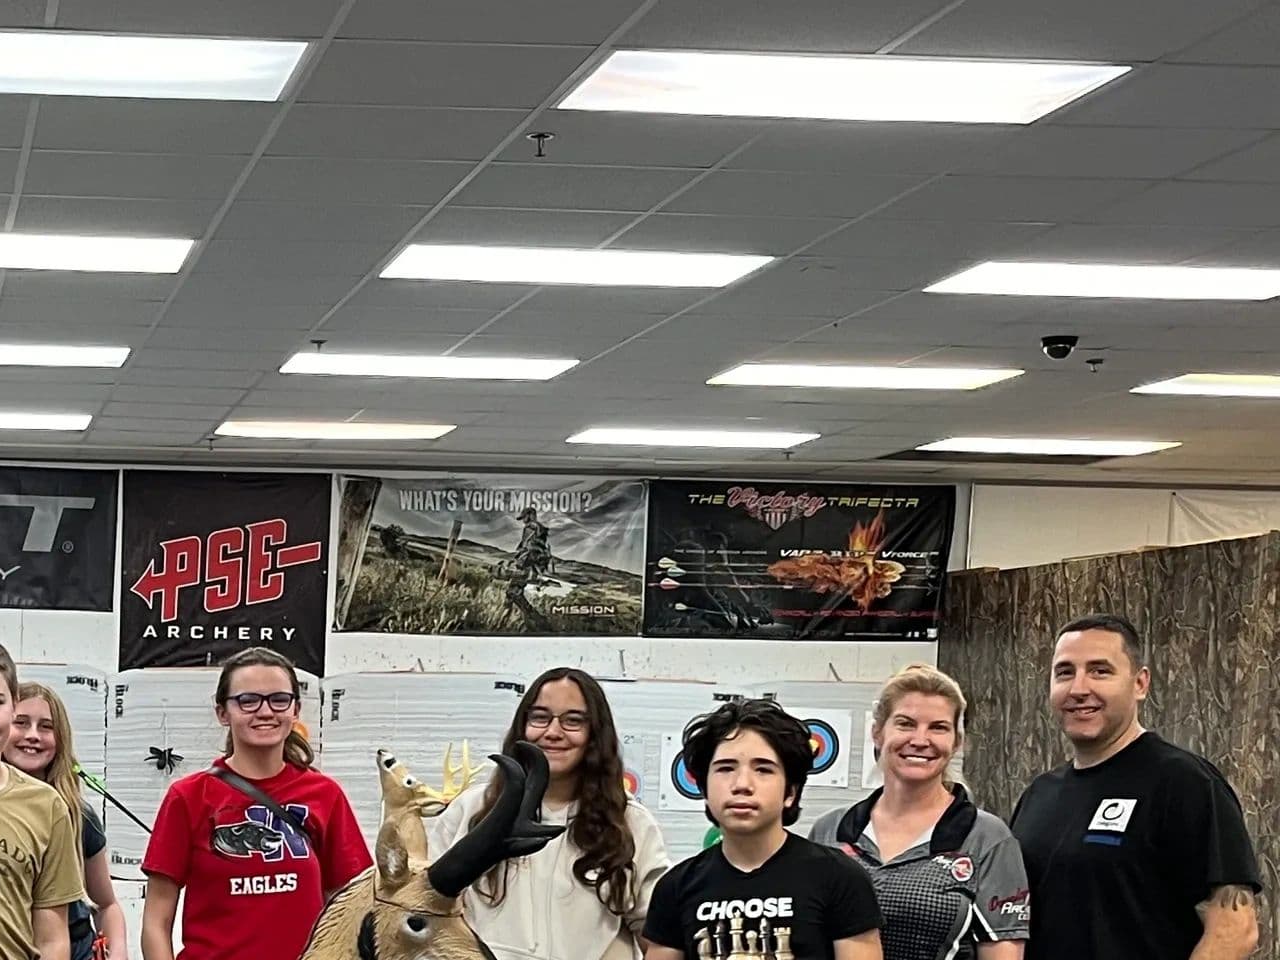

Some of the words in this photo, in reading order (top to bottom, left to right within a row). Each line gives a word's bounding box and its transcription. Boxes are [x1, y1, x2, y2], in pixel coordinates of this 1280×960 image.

[400, 489, 458, 511] WHAT'S
[463, 490, 505, 511] YOUR
[506, 491, 593, 513] MISSION?
[688, 494, 726, 504] THE
[827, 497, 919, 508] TRIFECTA
[157, 518, 288, 623] PSE
[552, 604, 615, 615] MISSION
[143, 625, 296, 641] ARCHERY
[230, 874, 297, 895] EAGLES
[696, 897, 794, 921] CHOOSE
